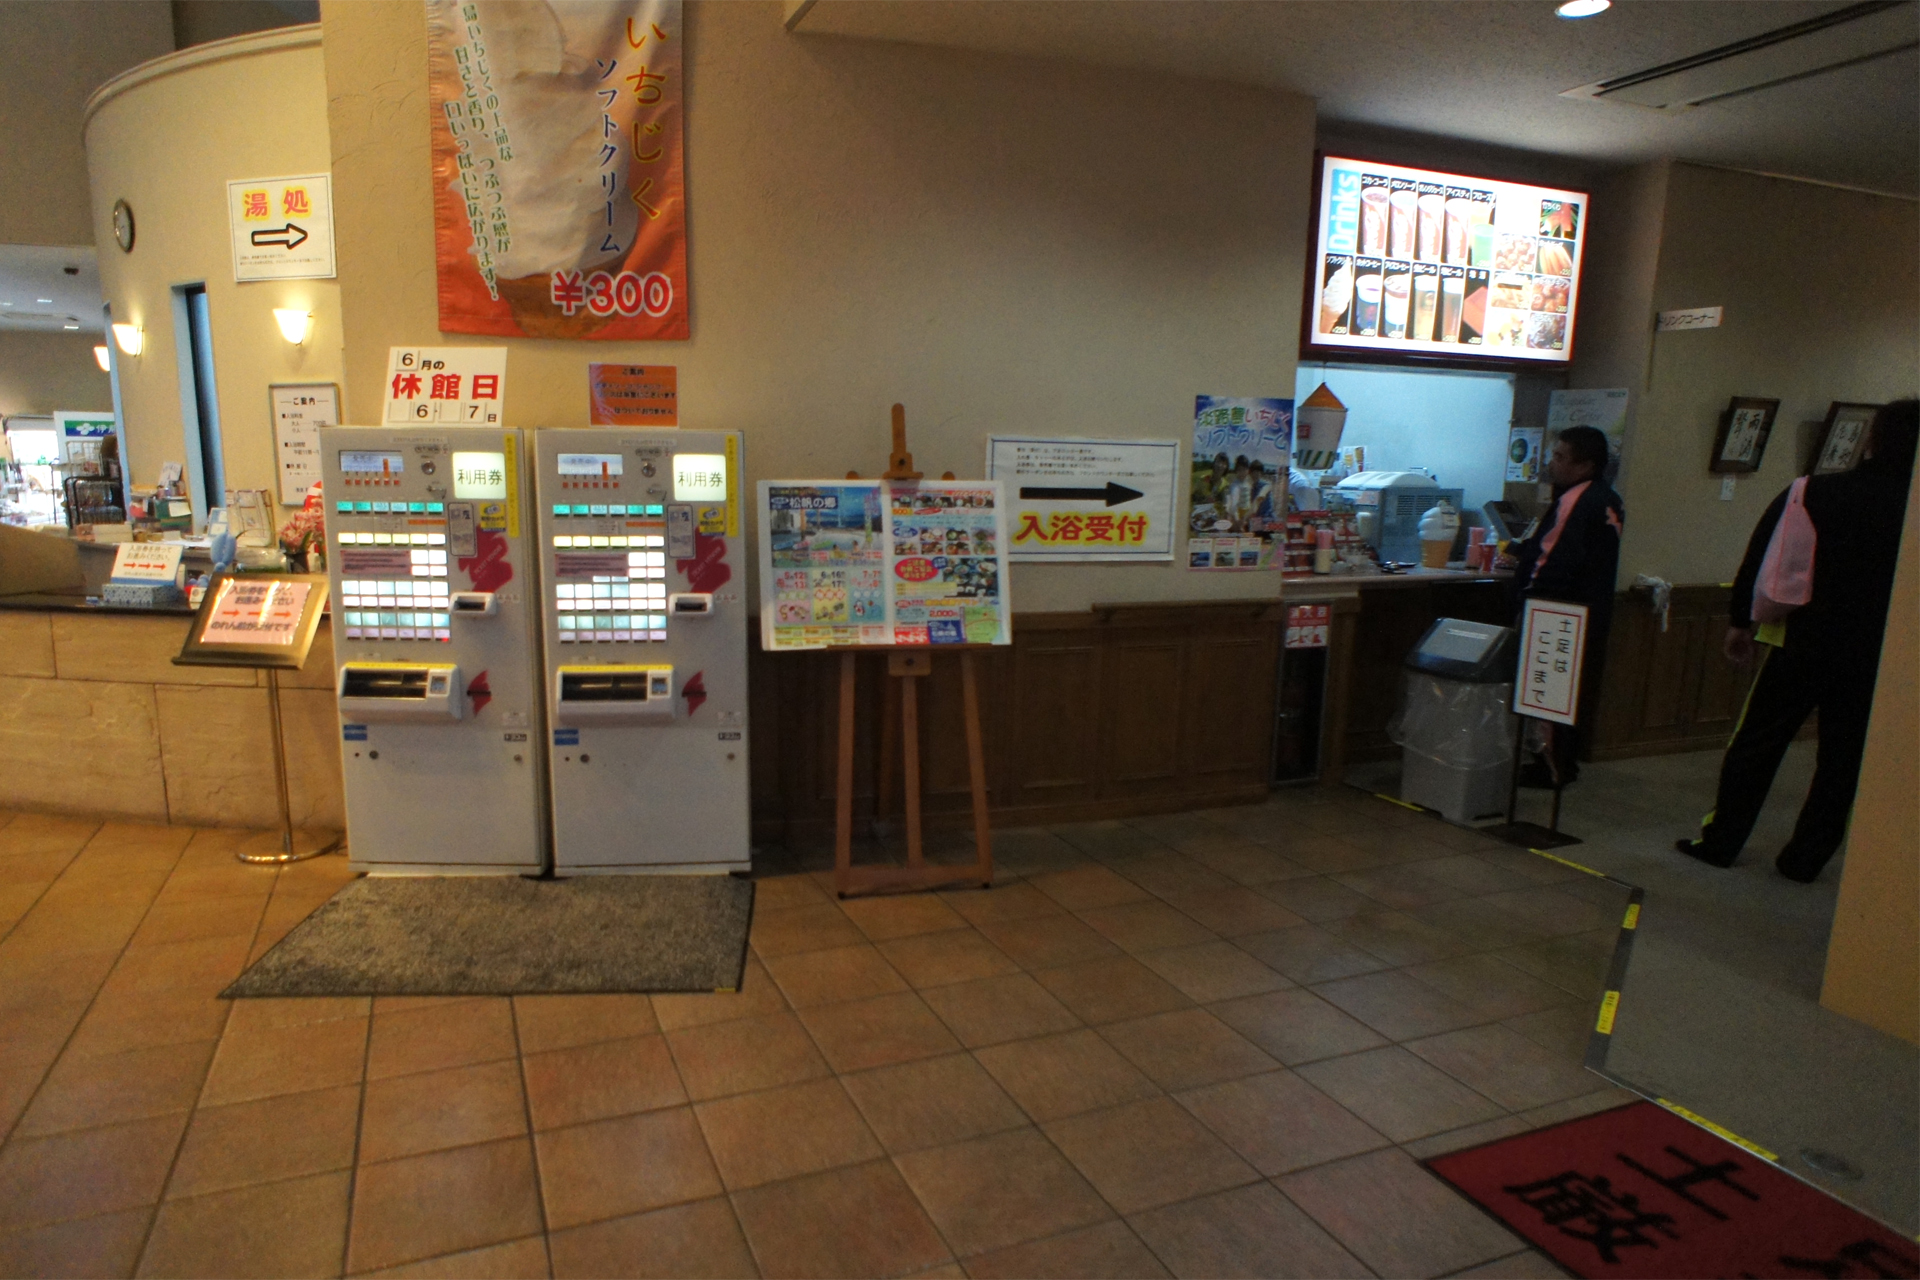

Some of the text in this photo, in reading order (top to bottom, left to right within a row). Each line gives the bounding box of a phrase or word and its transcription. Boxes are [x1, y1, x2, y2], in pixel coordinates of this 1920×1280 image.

[626, 16, 666, 219] いちじく
[597, 58, 620, 253] ソフトクリーム
[244, 190, 309, 217] 湯処
[1328, 171, 1361, 252] Drinks
[551, 271, 673, 316] ¥300
[392, 374, 498, 400] 休館日
[293, 397, 316, 406] ご案内
[1199, 406, 1291, 433] 淡路島いちじく
[1196, 428, 1288, 450] ソフトクリーム
[457, 469, 502, 485] 利用券
[678, 471, 723, 487] 利用券
[1016, 515, 1148, 541] 入浴受付
[1554, 619, 1572, 674] 土足は
[1532, 631, 1551, 704] ここまで
